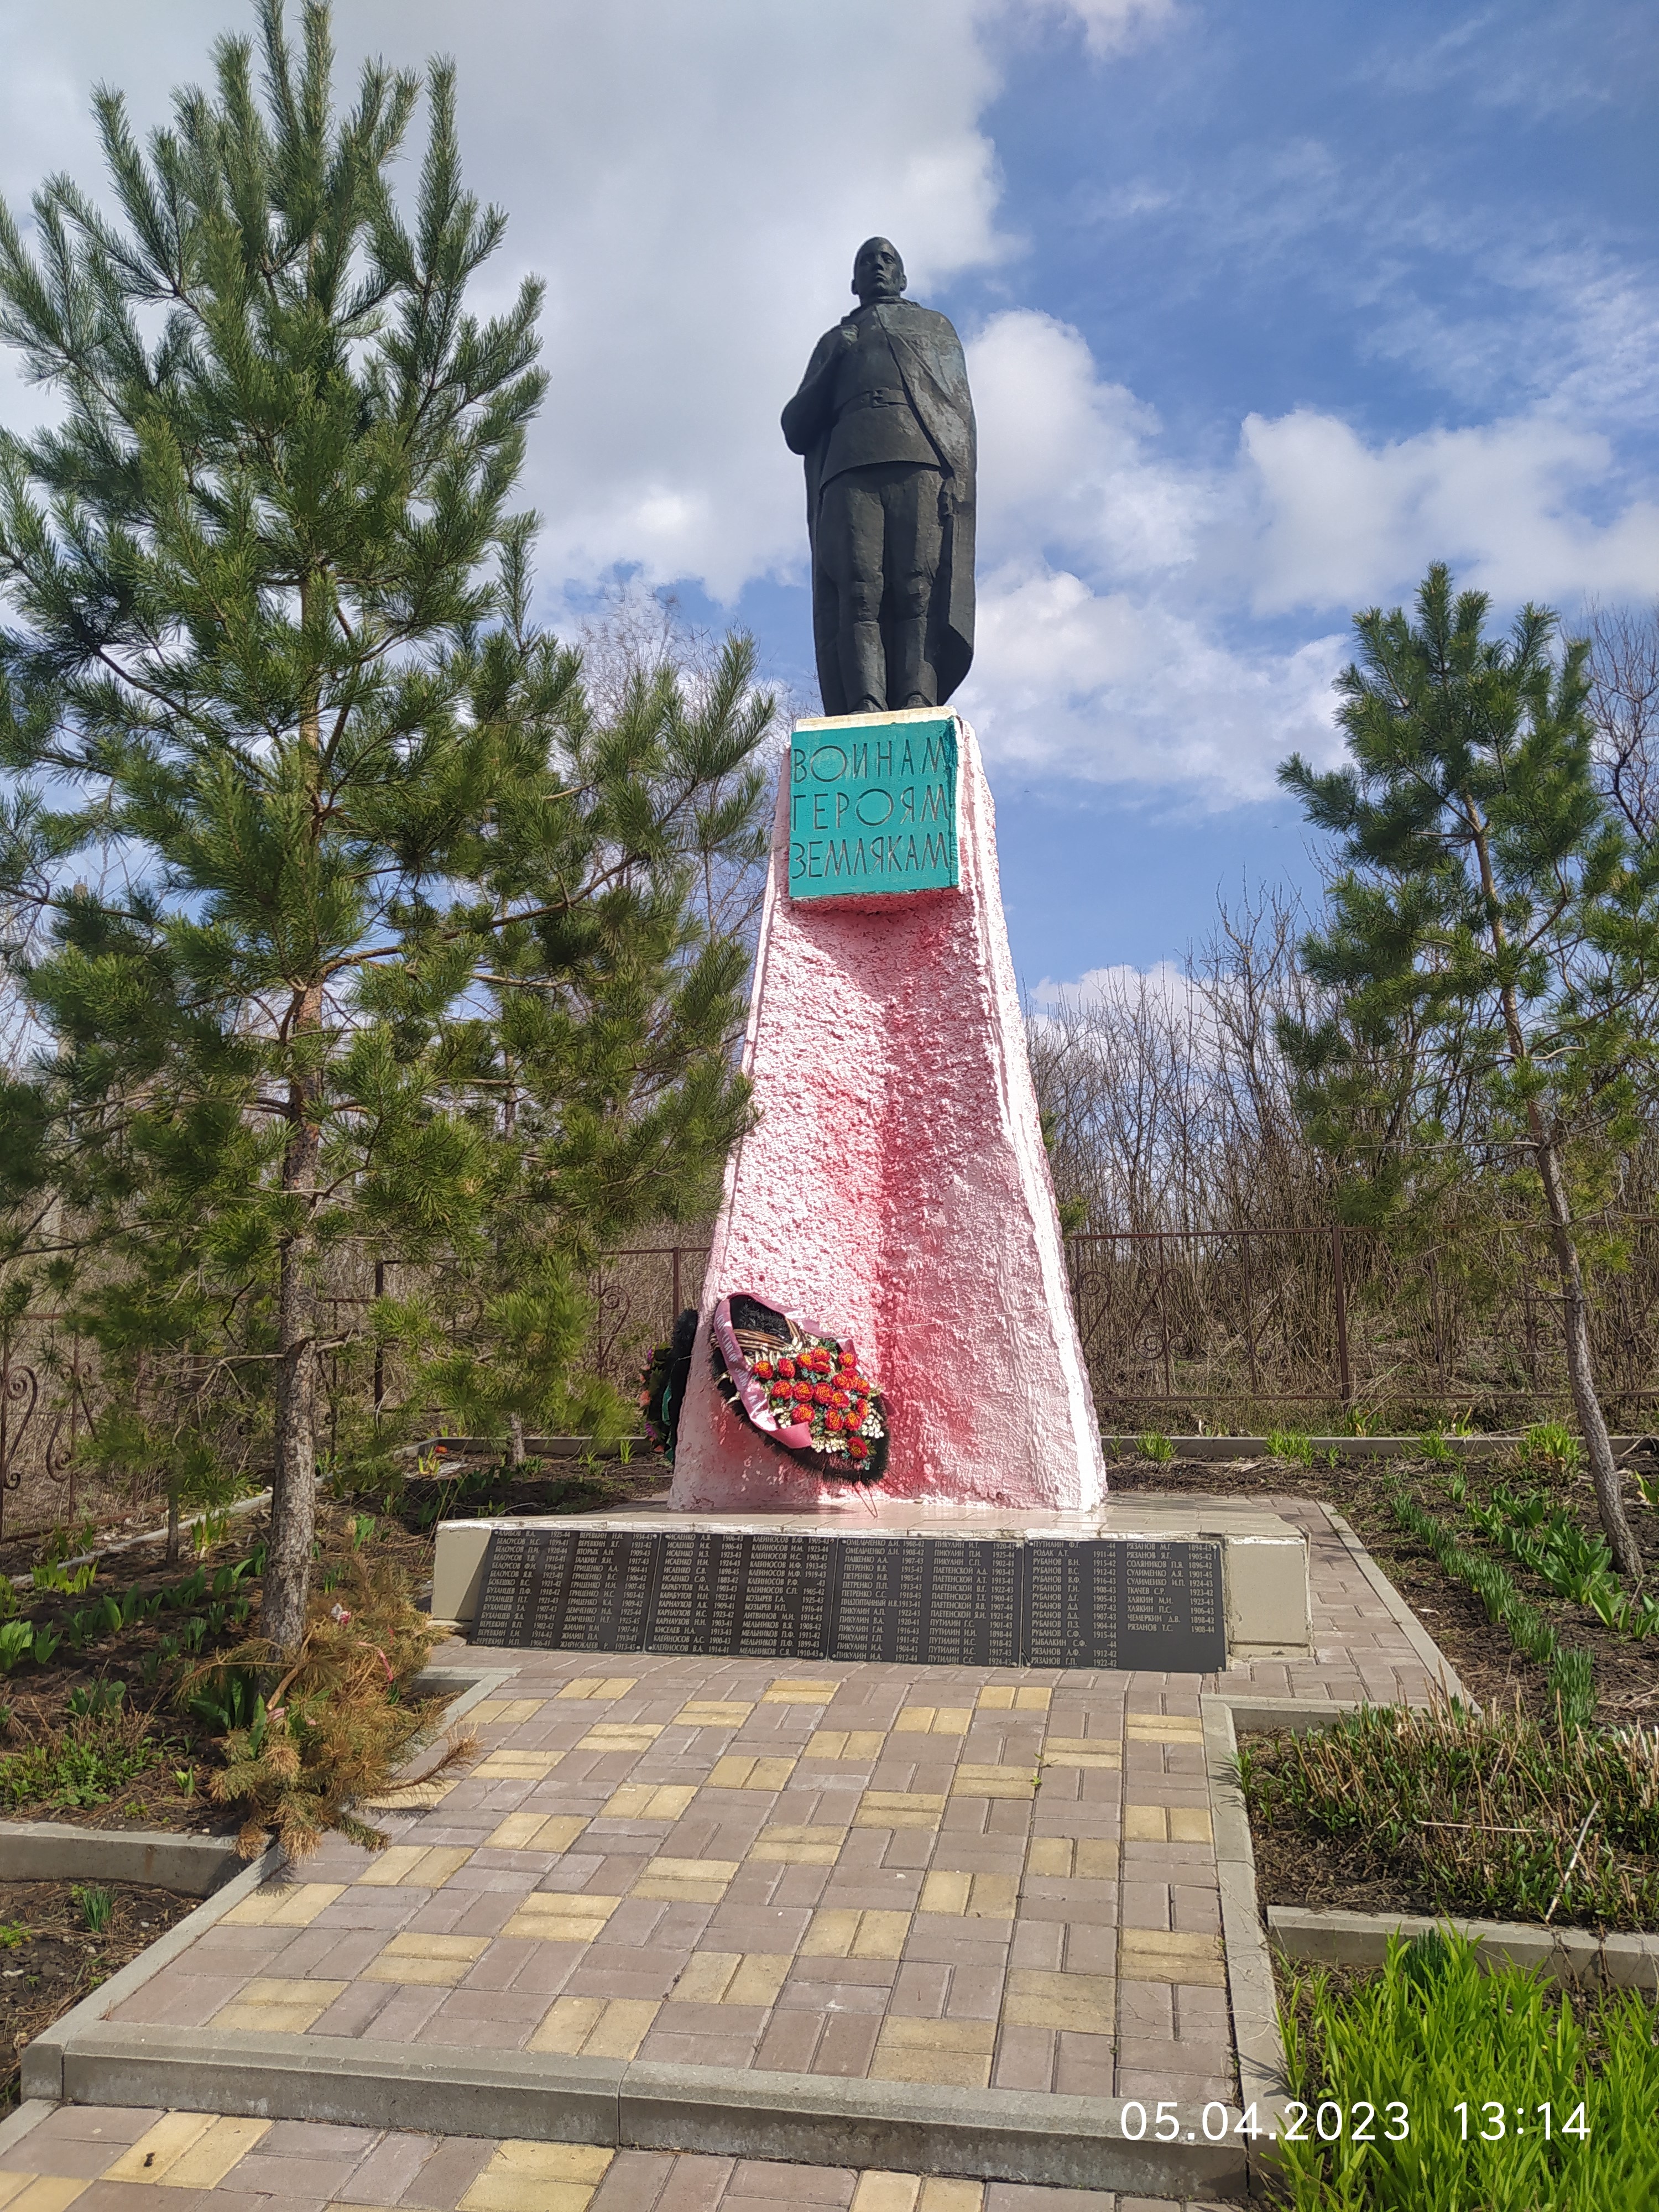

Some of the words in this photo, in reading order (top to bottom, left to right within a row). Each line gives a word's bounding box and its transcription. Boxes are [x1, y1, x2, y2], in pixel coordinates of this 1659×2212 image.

[794, 736, 949, 783] ВОИНАМ
[792, 784, 948, 831] ГЕРОЯМ
[790, 832, 949, 879] ЗЕМЛЯКАМ
